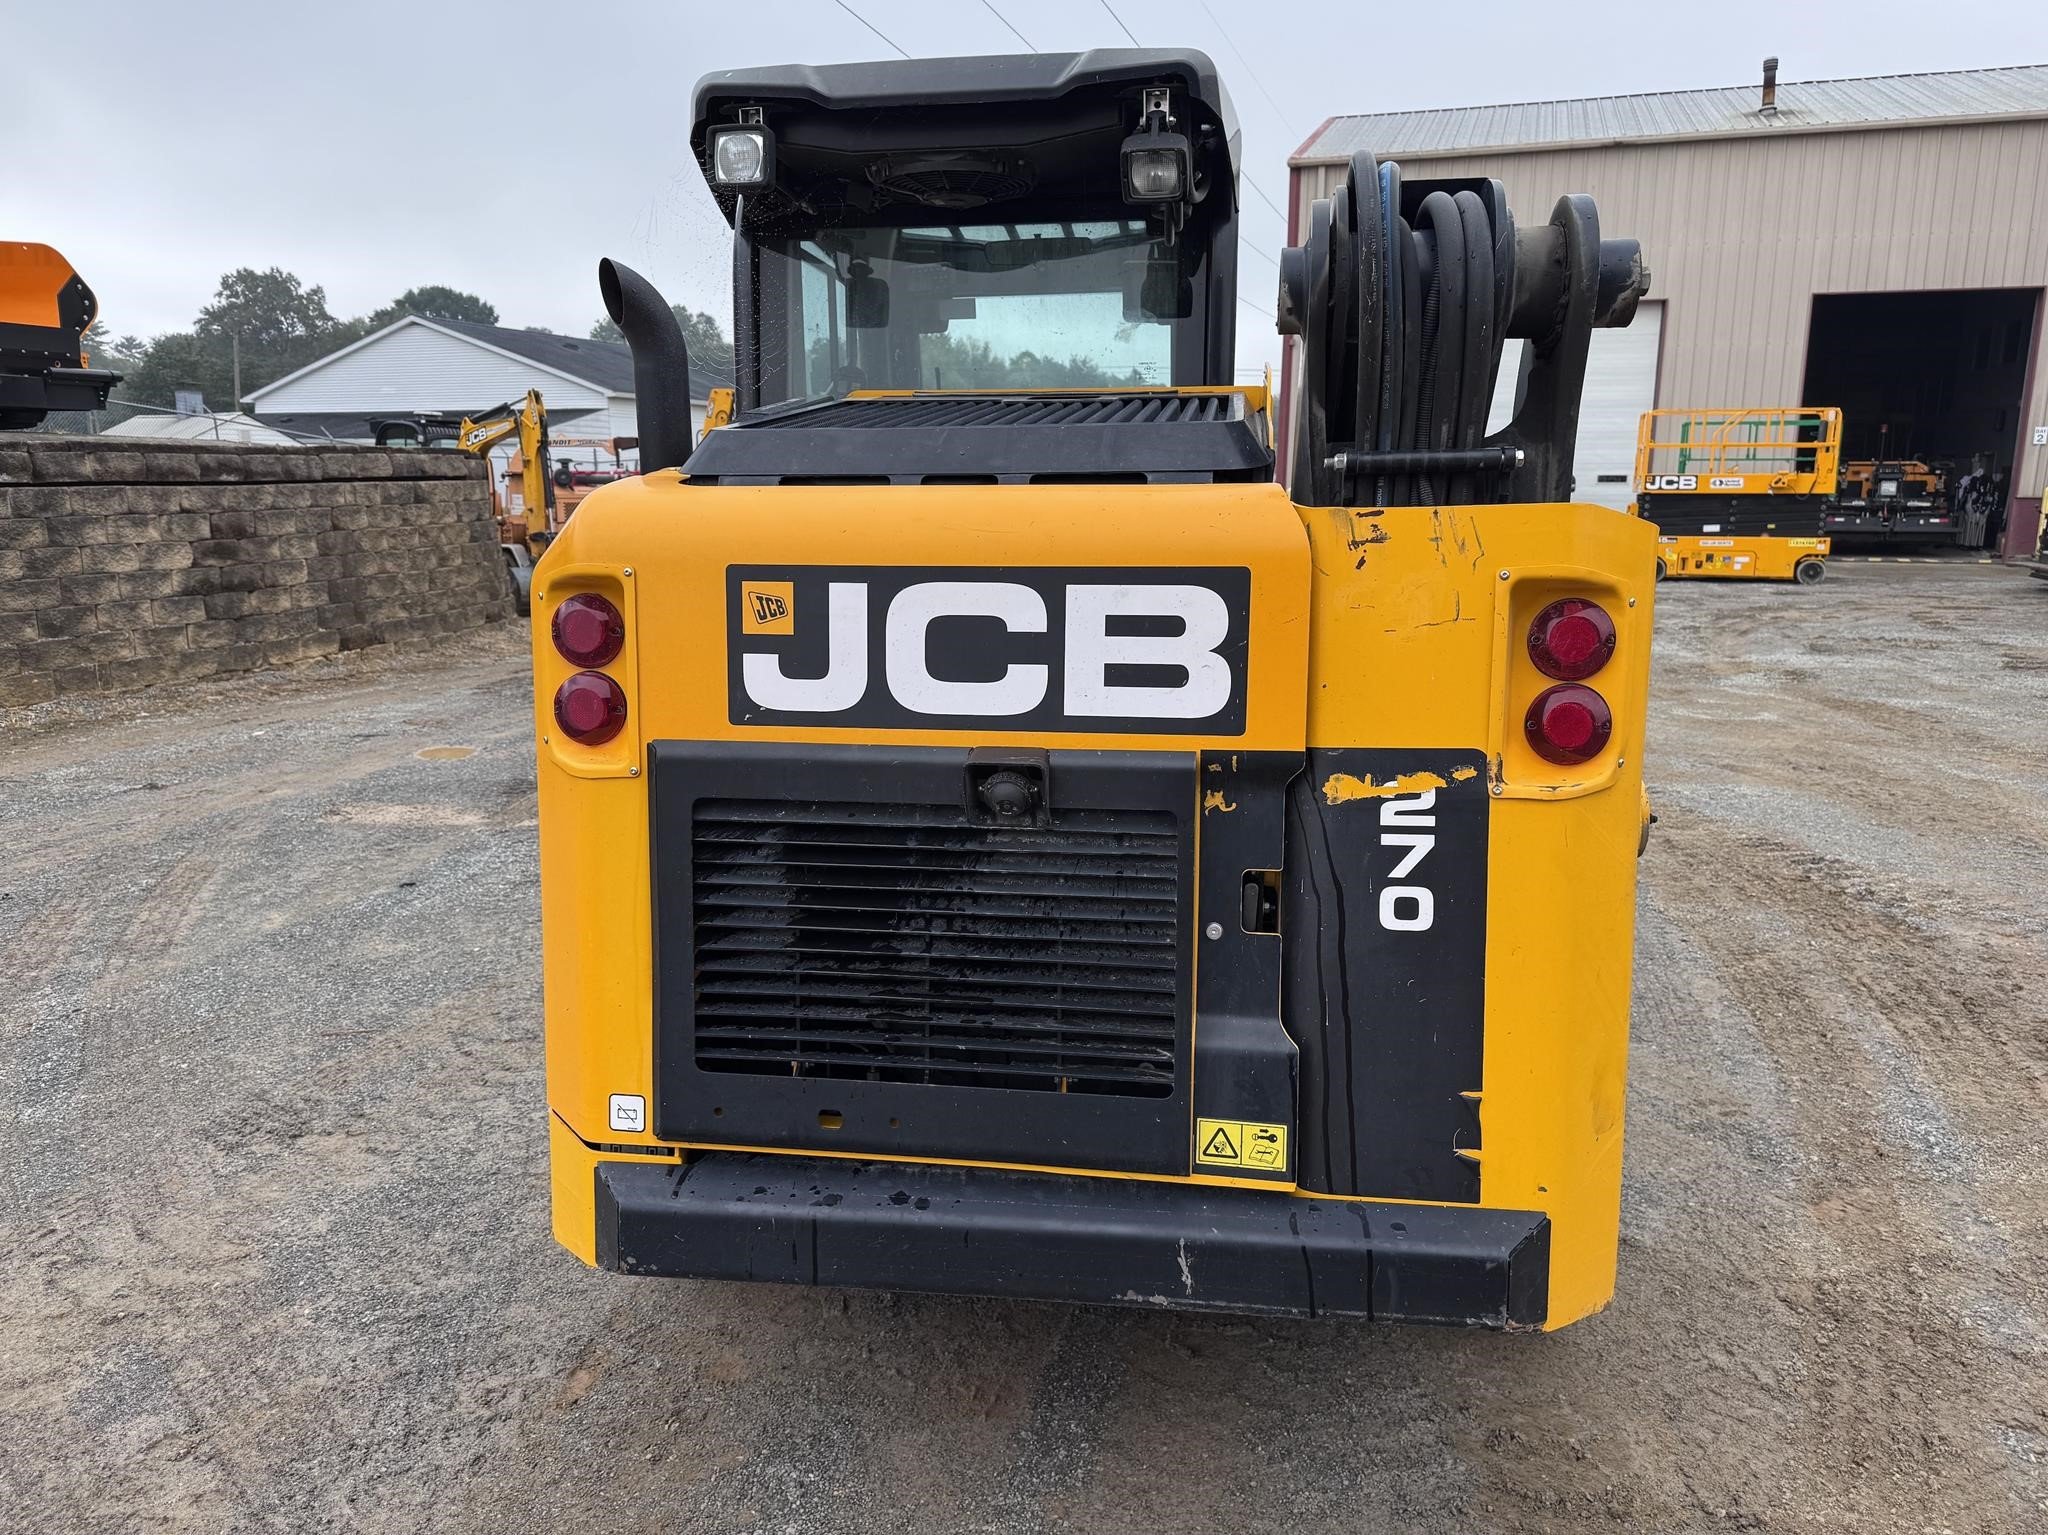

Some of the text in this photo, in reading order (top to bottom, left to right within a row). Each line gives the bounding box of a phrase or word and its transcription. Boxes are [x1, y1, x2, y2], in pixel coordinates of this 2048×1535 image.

[466, 428, 487, 446] JCB
[2036, 434, 2044, 442] 2
[1645, 476, 1697, 490] JCB
[755, 595, 786, 620] JCB
[742, 581, 1231, 719] JCB
[1379, 781, 1436, 931] 270
